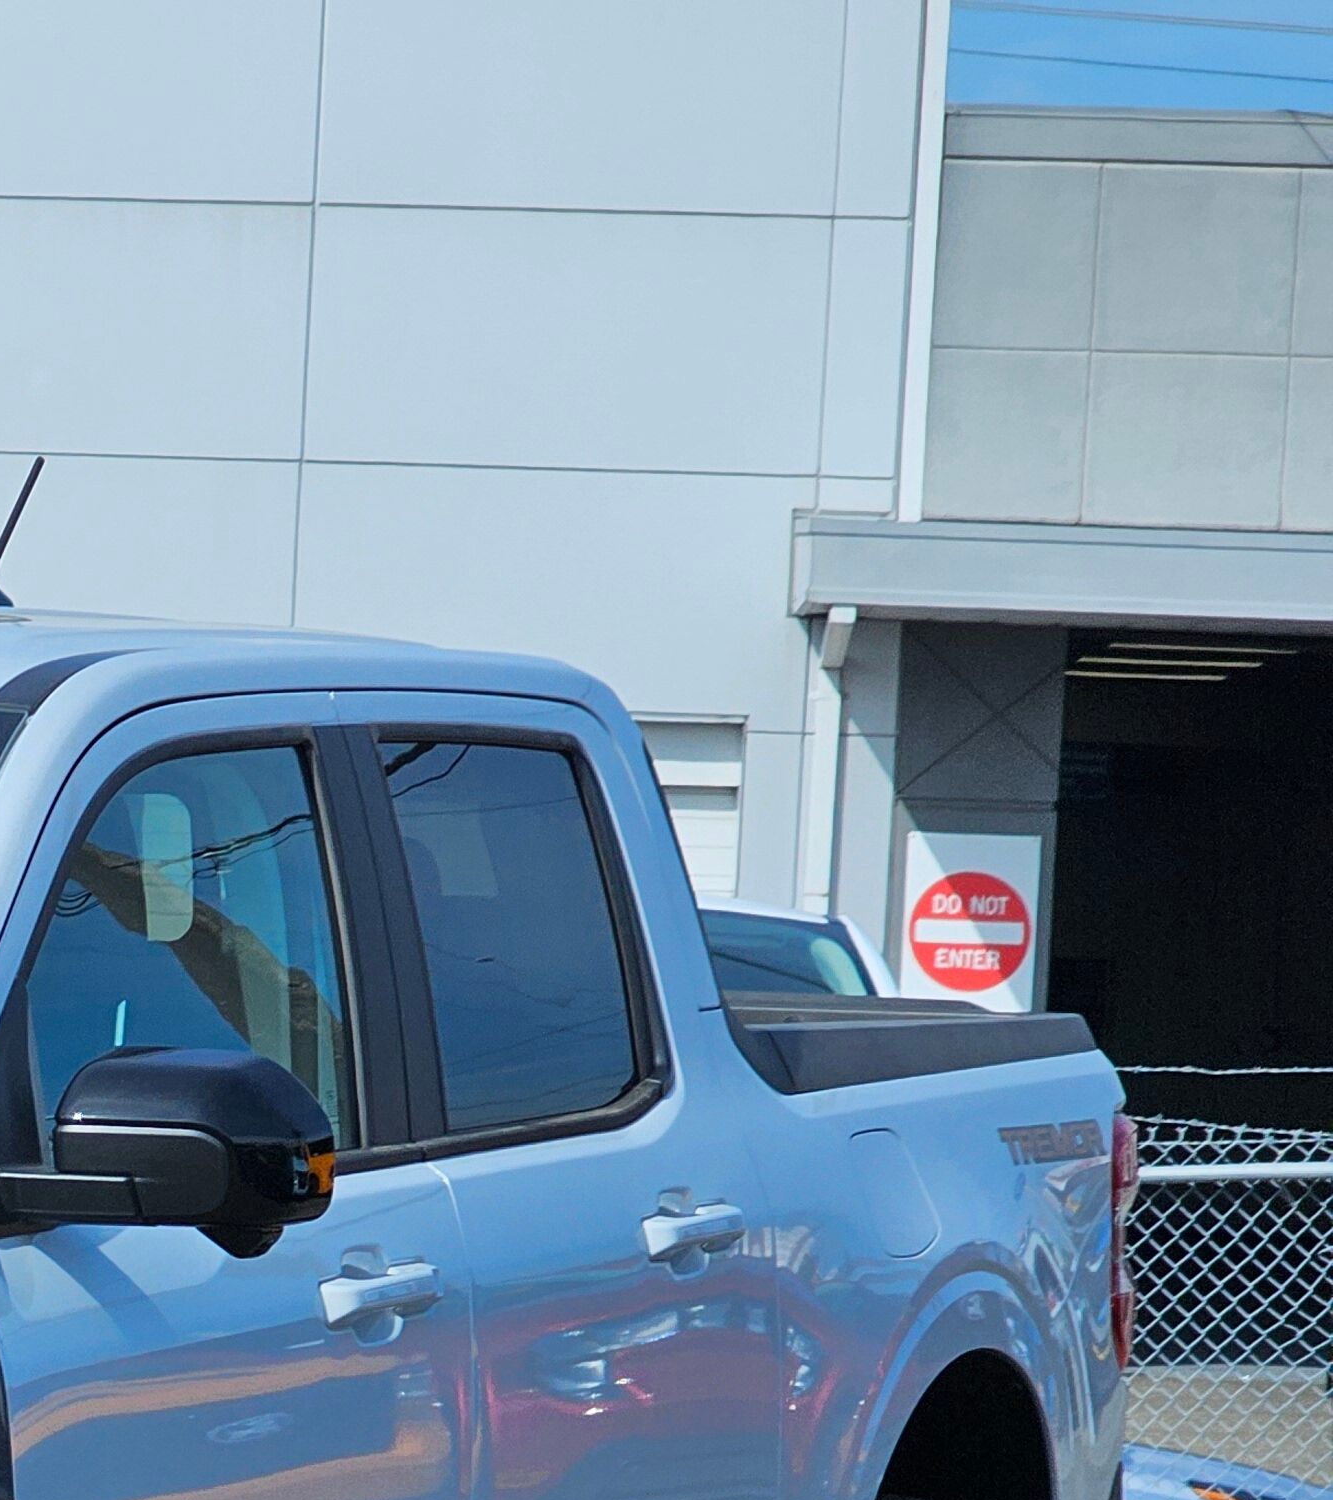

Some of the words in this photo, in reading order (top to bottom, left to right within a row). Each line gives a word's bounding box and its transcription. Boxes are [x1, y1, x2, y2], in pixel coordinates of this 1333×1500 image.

[931, 892, 963, 915] DO
[969, 894, 1010, 916] NOT
[933, 946, 1001, 972] ENTER
[997, 1118, 1109, 1167] TREMOR
